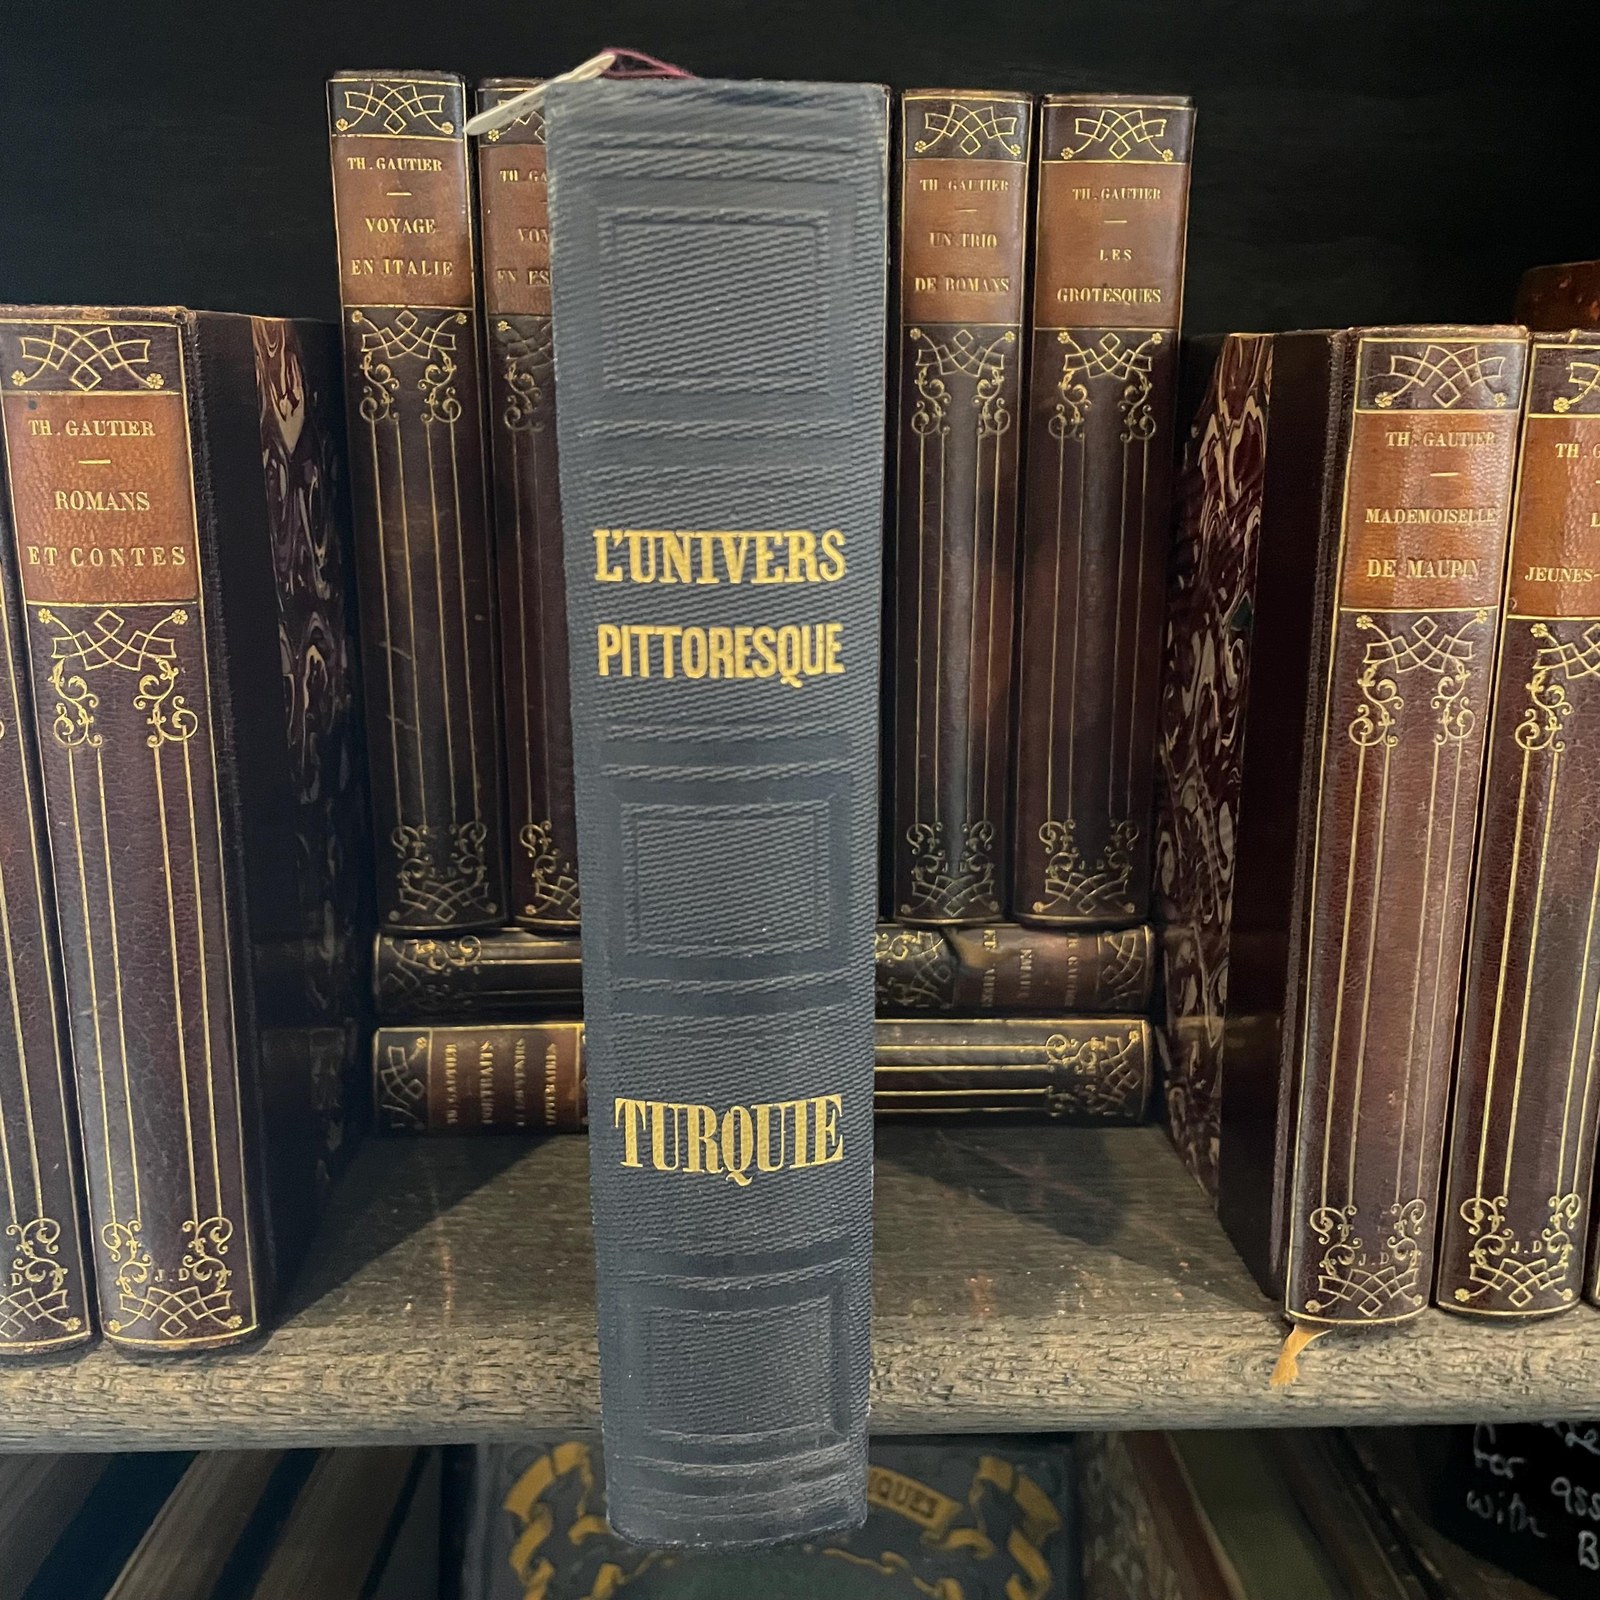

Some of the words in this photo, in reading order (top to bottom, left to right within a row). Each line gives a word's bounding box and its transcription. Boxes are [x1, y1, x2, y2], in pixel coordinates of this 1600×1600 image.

[376, 157, 443, 172] GAUTIER
[948, 179, 1009, 192] GAUTIER
[1101, 187, 1161, 201] GAUTIER
[365, 218, 436, 234] VOYAGE
[929, 232, 953, 247] UN
[961, 232, 998, 248] TRIO
[1099, 248, 1132, 261] LES
[351, 259, 375, 276] EN
[381, 258, 454, 276] ITALIE
[915, 276, 937, 292] DE
[944, 276, 1009, 292] ROMANS
[28, 419, 61, 436] TH.
[65, 420, 156, 437] GAUTIER
[1422, 431, 1496, 447] GAUTIER
[54, 490, 151, 511] ROMANS
[1365, 508, 1500, 524] MADEMOISELLE
[27, 545, 58, 567] ET
[70, 545, 186, 567] CONTES
[593, 528, 847, 584] L'UNIVERS
[1366, 559, 1397, 577] DE
[1406, 559, 1482, 578] MAUPIN
[597, 622, 846, 688] PITTORESQUE
[614, 1094, 844, 1187] TURQUIE
